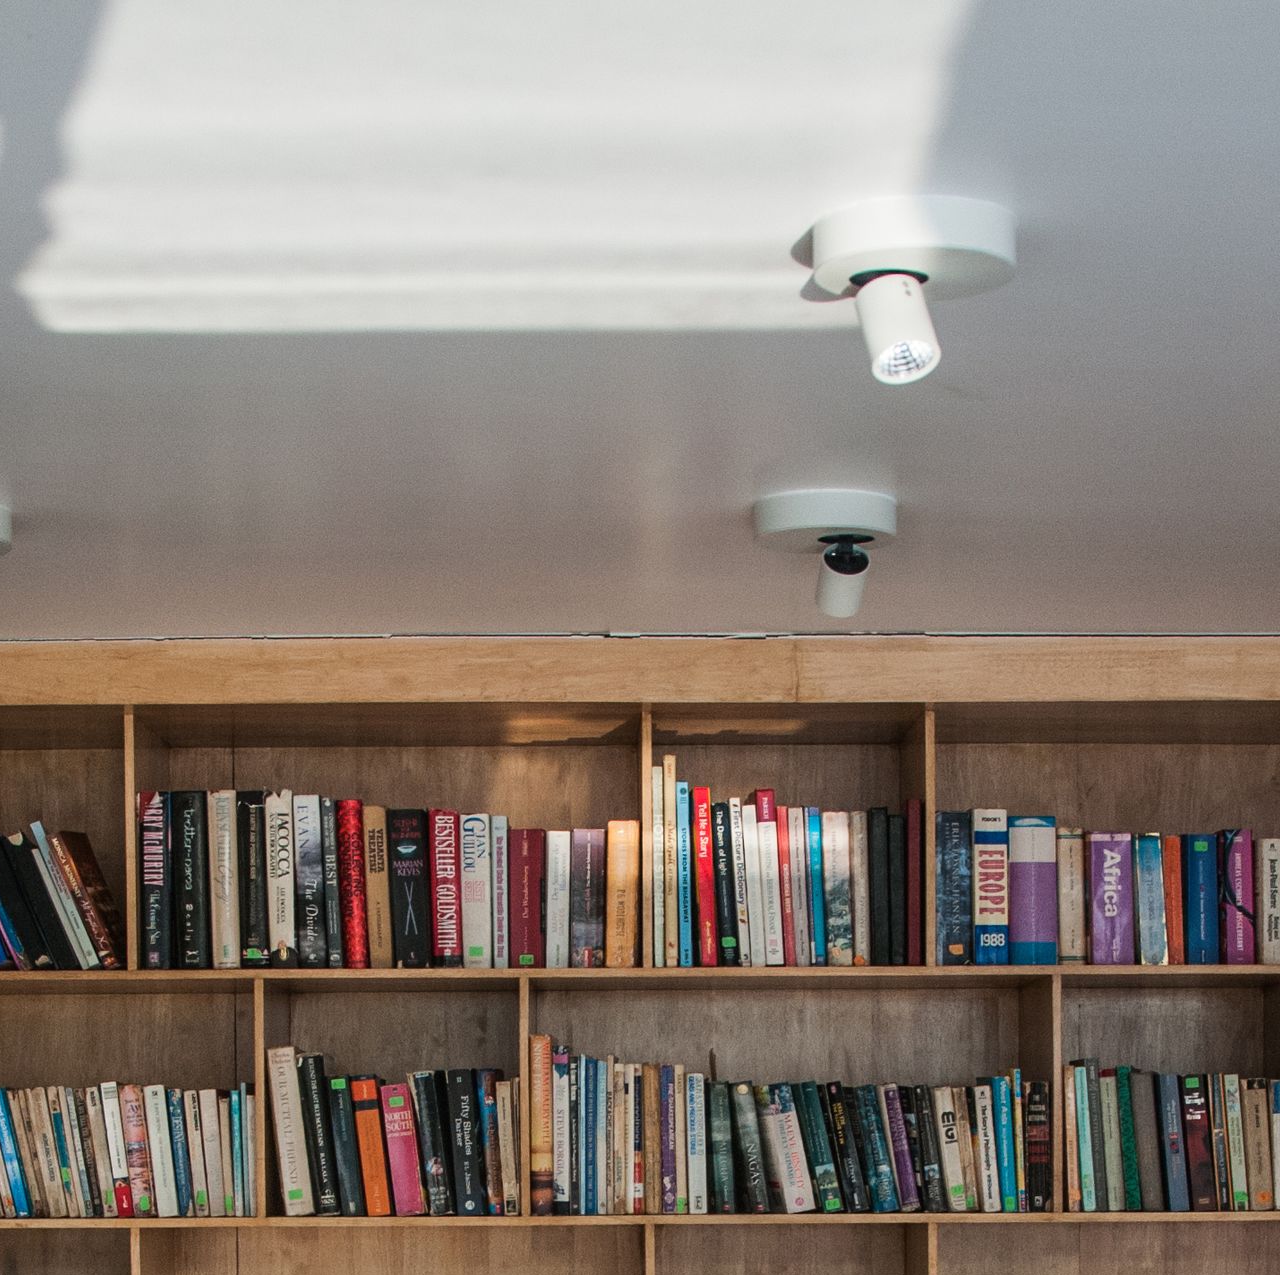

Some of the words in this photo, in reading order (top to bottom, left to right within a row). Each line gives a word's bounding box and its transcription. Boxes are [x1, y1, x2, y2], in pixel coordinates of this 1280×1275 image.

[699, 803, 707, 816] Tell
[732, 810, 740, 830] First
[278, 812, 290, 878] IACOCCA
[297, 805, 310, 860] EVANS
[434, 815, 456, 878] BESTSELLER
[476, 834, 486, 859] JAN
[653, 814, 663, 857] HOTEL
[699, 837, 708, 858] Story
[717, 826, 725, 847] Dawn
[734, 831, 742, 861] Picture
[51, 837, 67, 863] MONICA
[368, 829, 376, 874] TREATISE
[377, 829, 385, 873] VEDANTA
[325, 854, 337, 887] BEST
[718, 858, 727, 876] Light
[978, 850, 1005, 915] EUROPE
[1102, 849, 1121, 917] Africa
[304, 879, 317, 901] The
[736, 863, 745, 904] Dictionary
[305, 904, 319, 942] Divide
[436, 884, 457, 948] GOLDSMITH
[952, 889, 960, 934] HANSEN
[980, 933, 1005, 947] 1988
[533, 1044, 542, 1071] NINE
[385, 1110, 411, 1123] NORTH
[460, 1095, 470, 1119] Fifty
[385, 1120, 413, 1132] SOUTH
[455, 1118, 463, 1147] Darker
[463, 1121, 473, 1155] Shades
[746, 1143, 759, 1186] NAGAS
[982, 1139, 992, 1171] Philosophy
